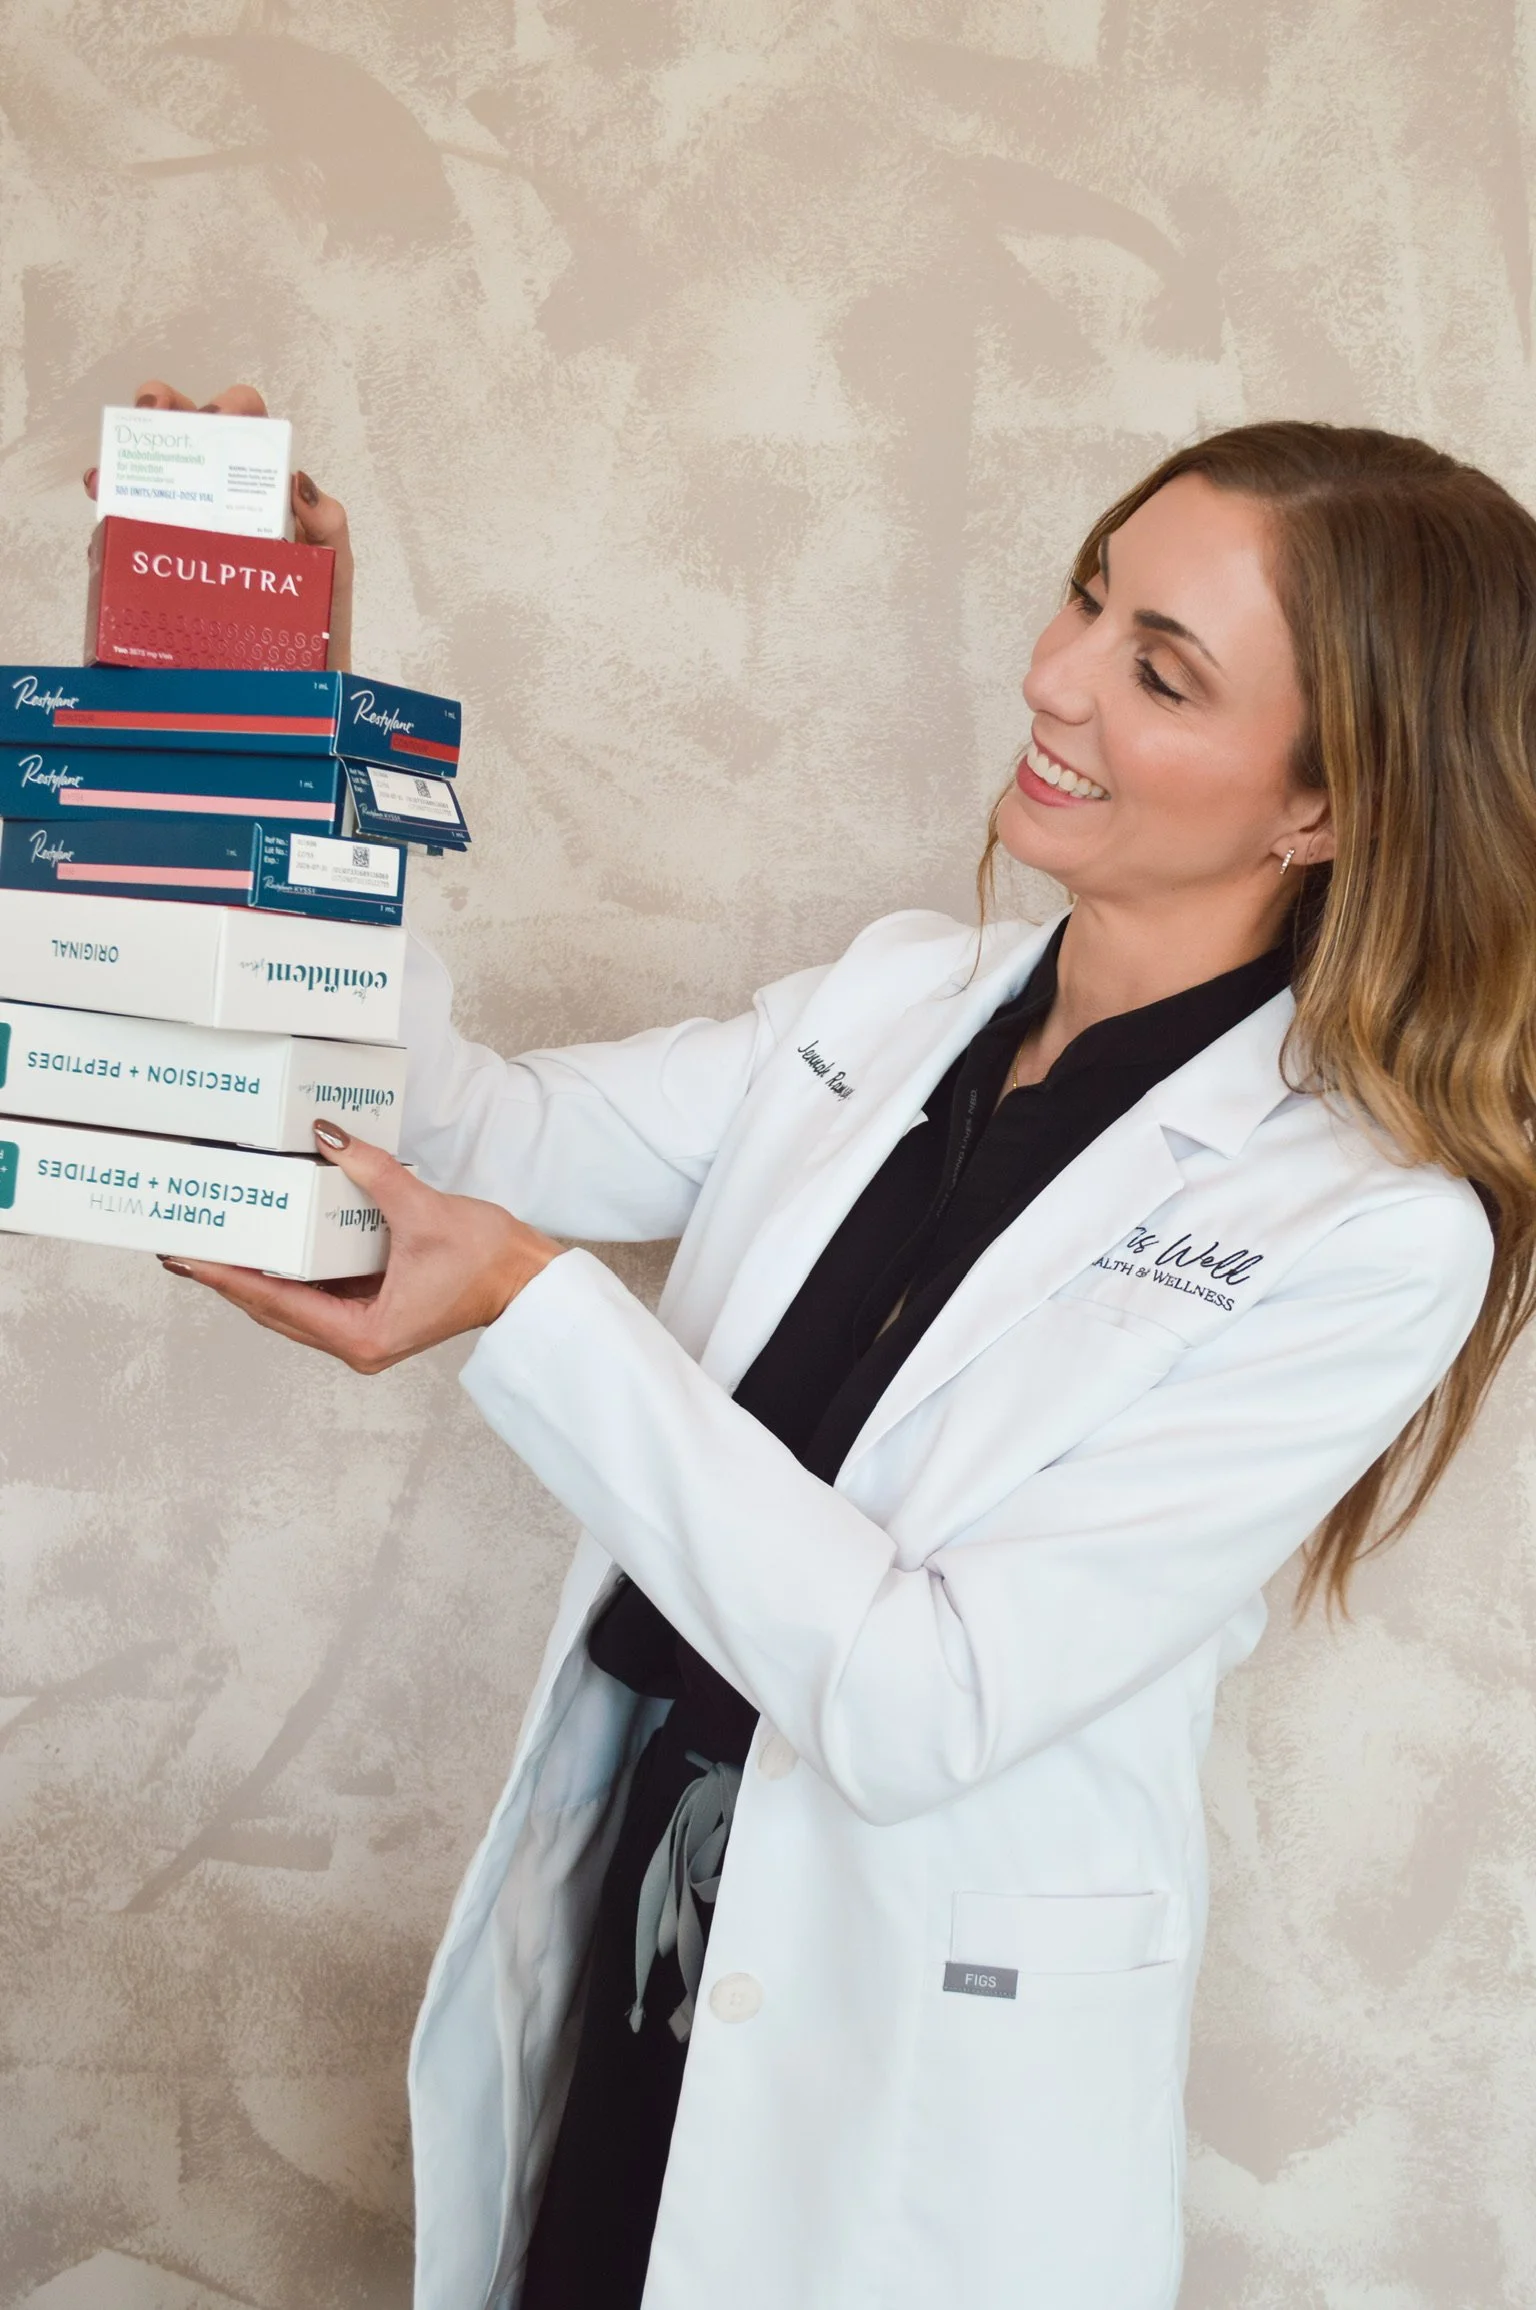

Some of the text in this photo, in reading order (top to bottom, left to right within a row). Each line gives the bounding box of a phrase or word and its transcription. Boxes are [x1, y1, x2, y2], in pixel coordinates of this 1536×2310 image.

[350, 690, 415, 736] Restylane
[51, 939, 119, 963] ORIGINAL
[266, 962, 388, 993] confident
[27, 1051, 260, 1095] PRECISION + PEPTIDES
[315, 1084, 395, 1112] confident
[37, 1159, 289, 1210] PRECISION + PEPTIDES
[90, 1192, 226, 1228] PURIFY WITH
[1154, 1233, 1264, 1286] Well
[1135, 1266, 1152, 1278] &
[1152, 1268, 1236, 1312] WELLNESS
[965, 1973, 997, 1988] FIGS
